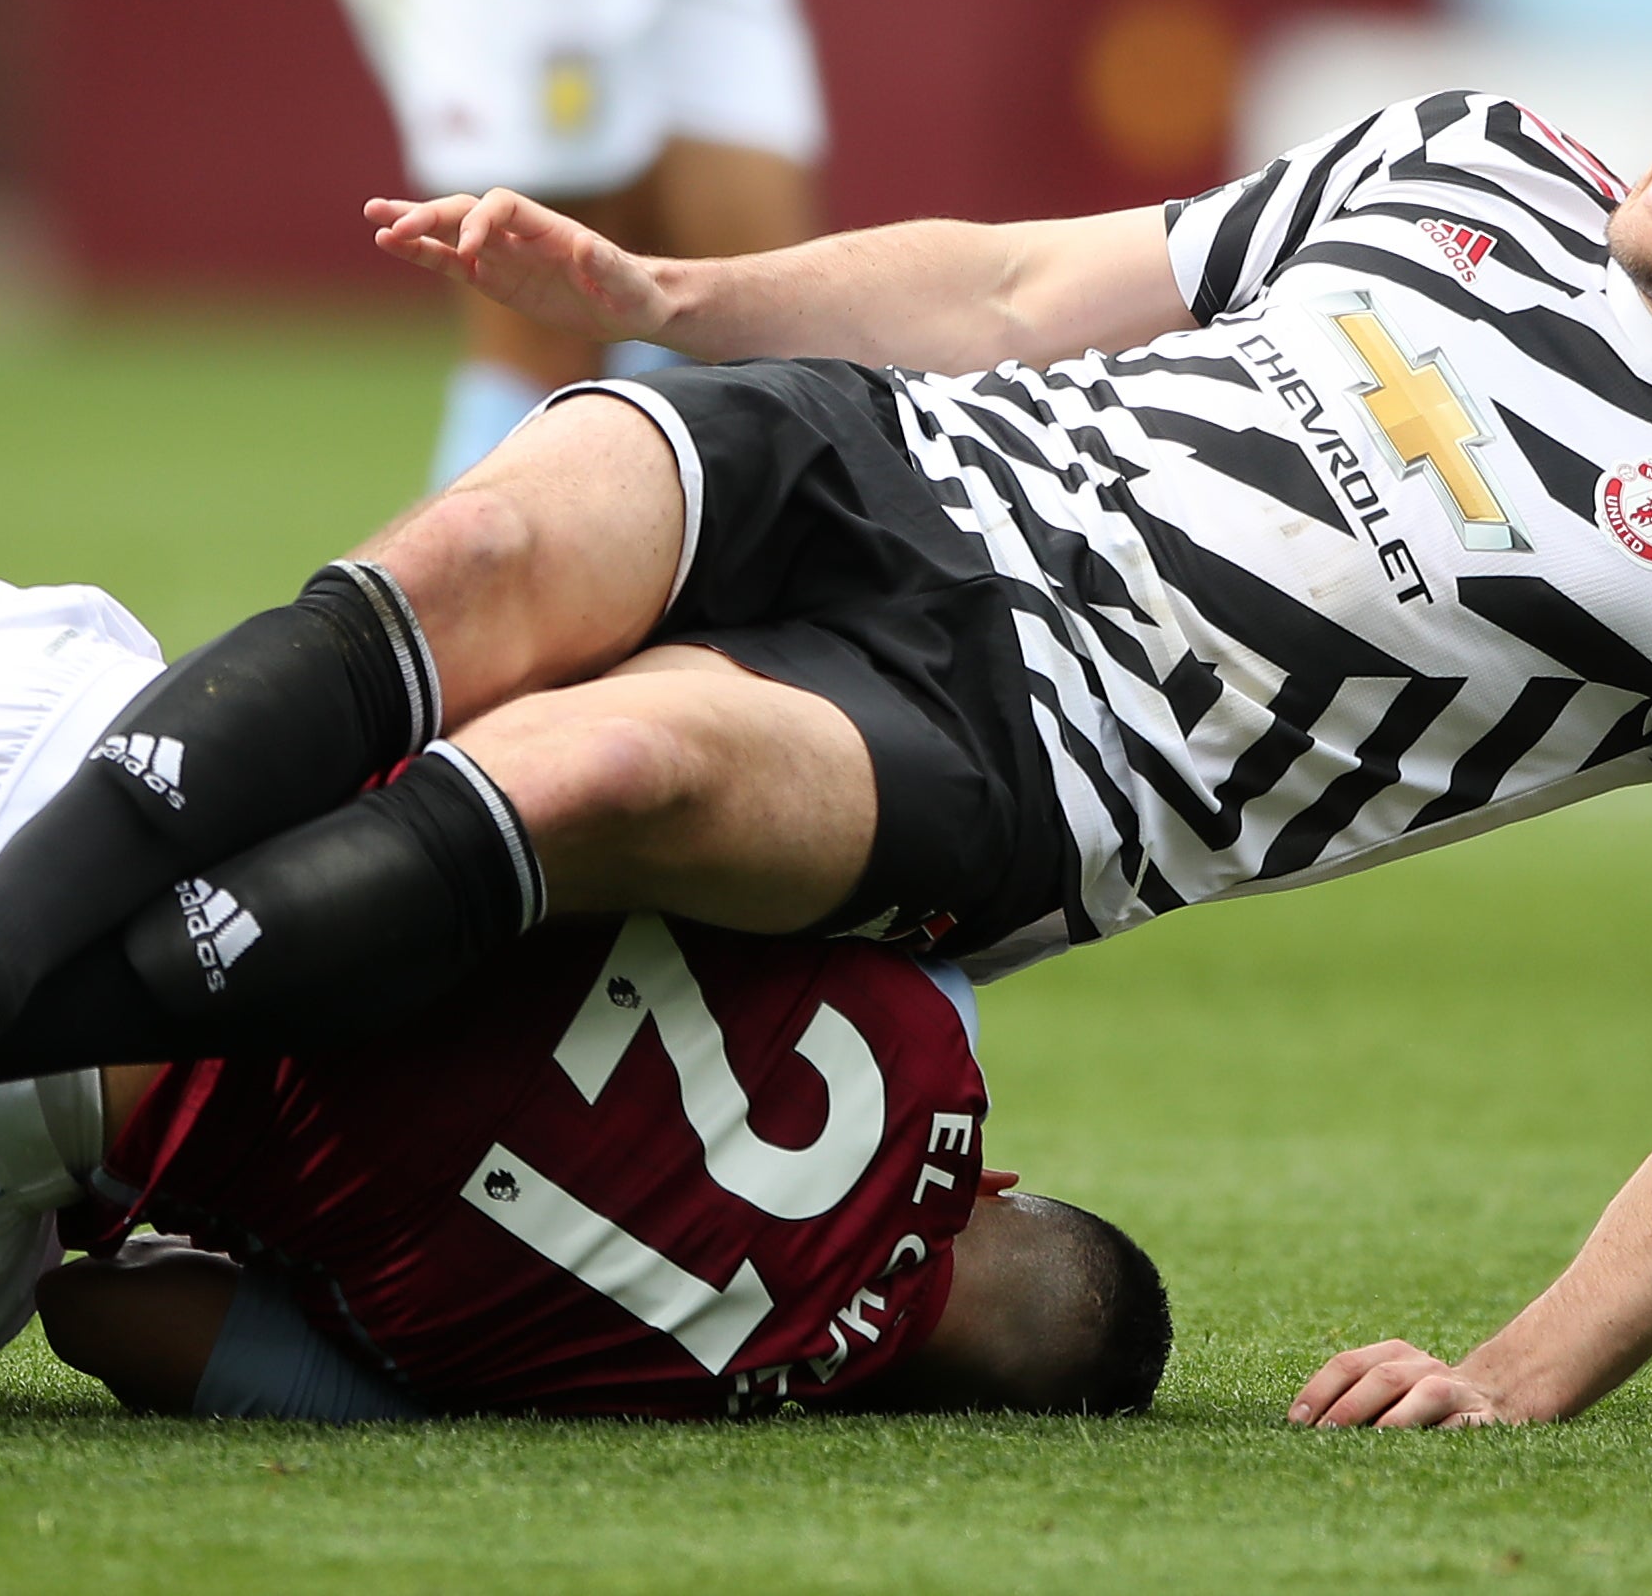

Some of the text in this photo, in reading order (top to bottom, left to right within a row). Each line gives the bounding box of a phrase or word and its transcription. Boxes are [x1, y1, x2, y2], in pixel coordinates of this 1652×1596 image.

[1419, 218, 1477, 284] adidas
[1235, 334, 1434, 605] CHEVROLET
[1605, 495, 1644, 553] UNITED
[88, 744, 186, 811] adidas
[174, 879, 225, 993] adidas
[459, 912, 886, 1376] 21
[911, 1112, 973, 1205] EL
